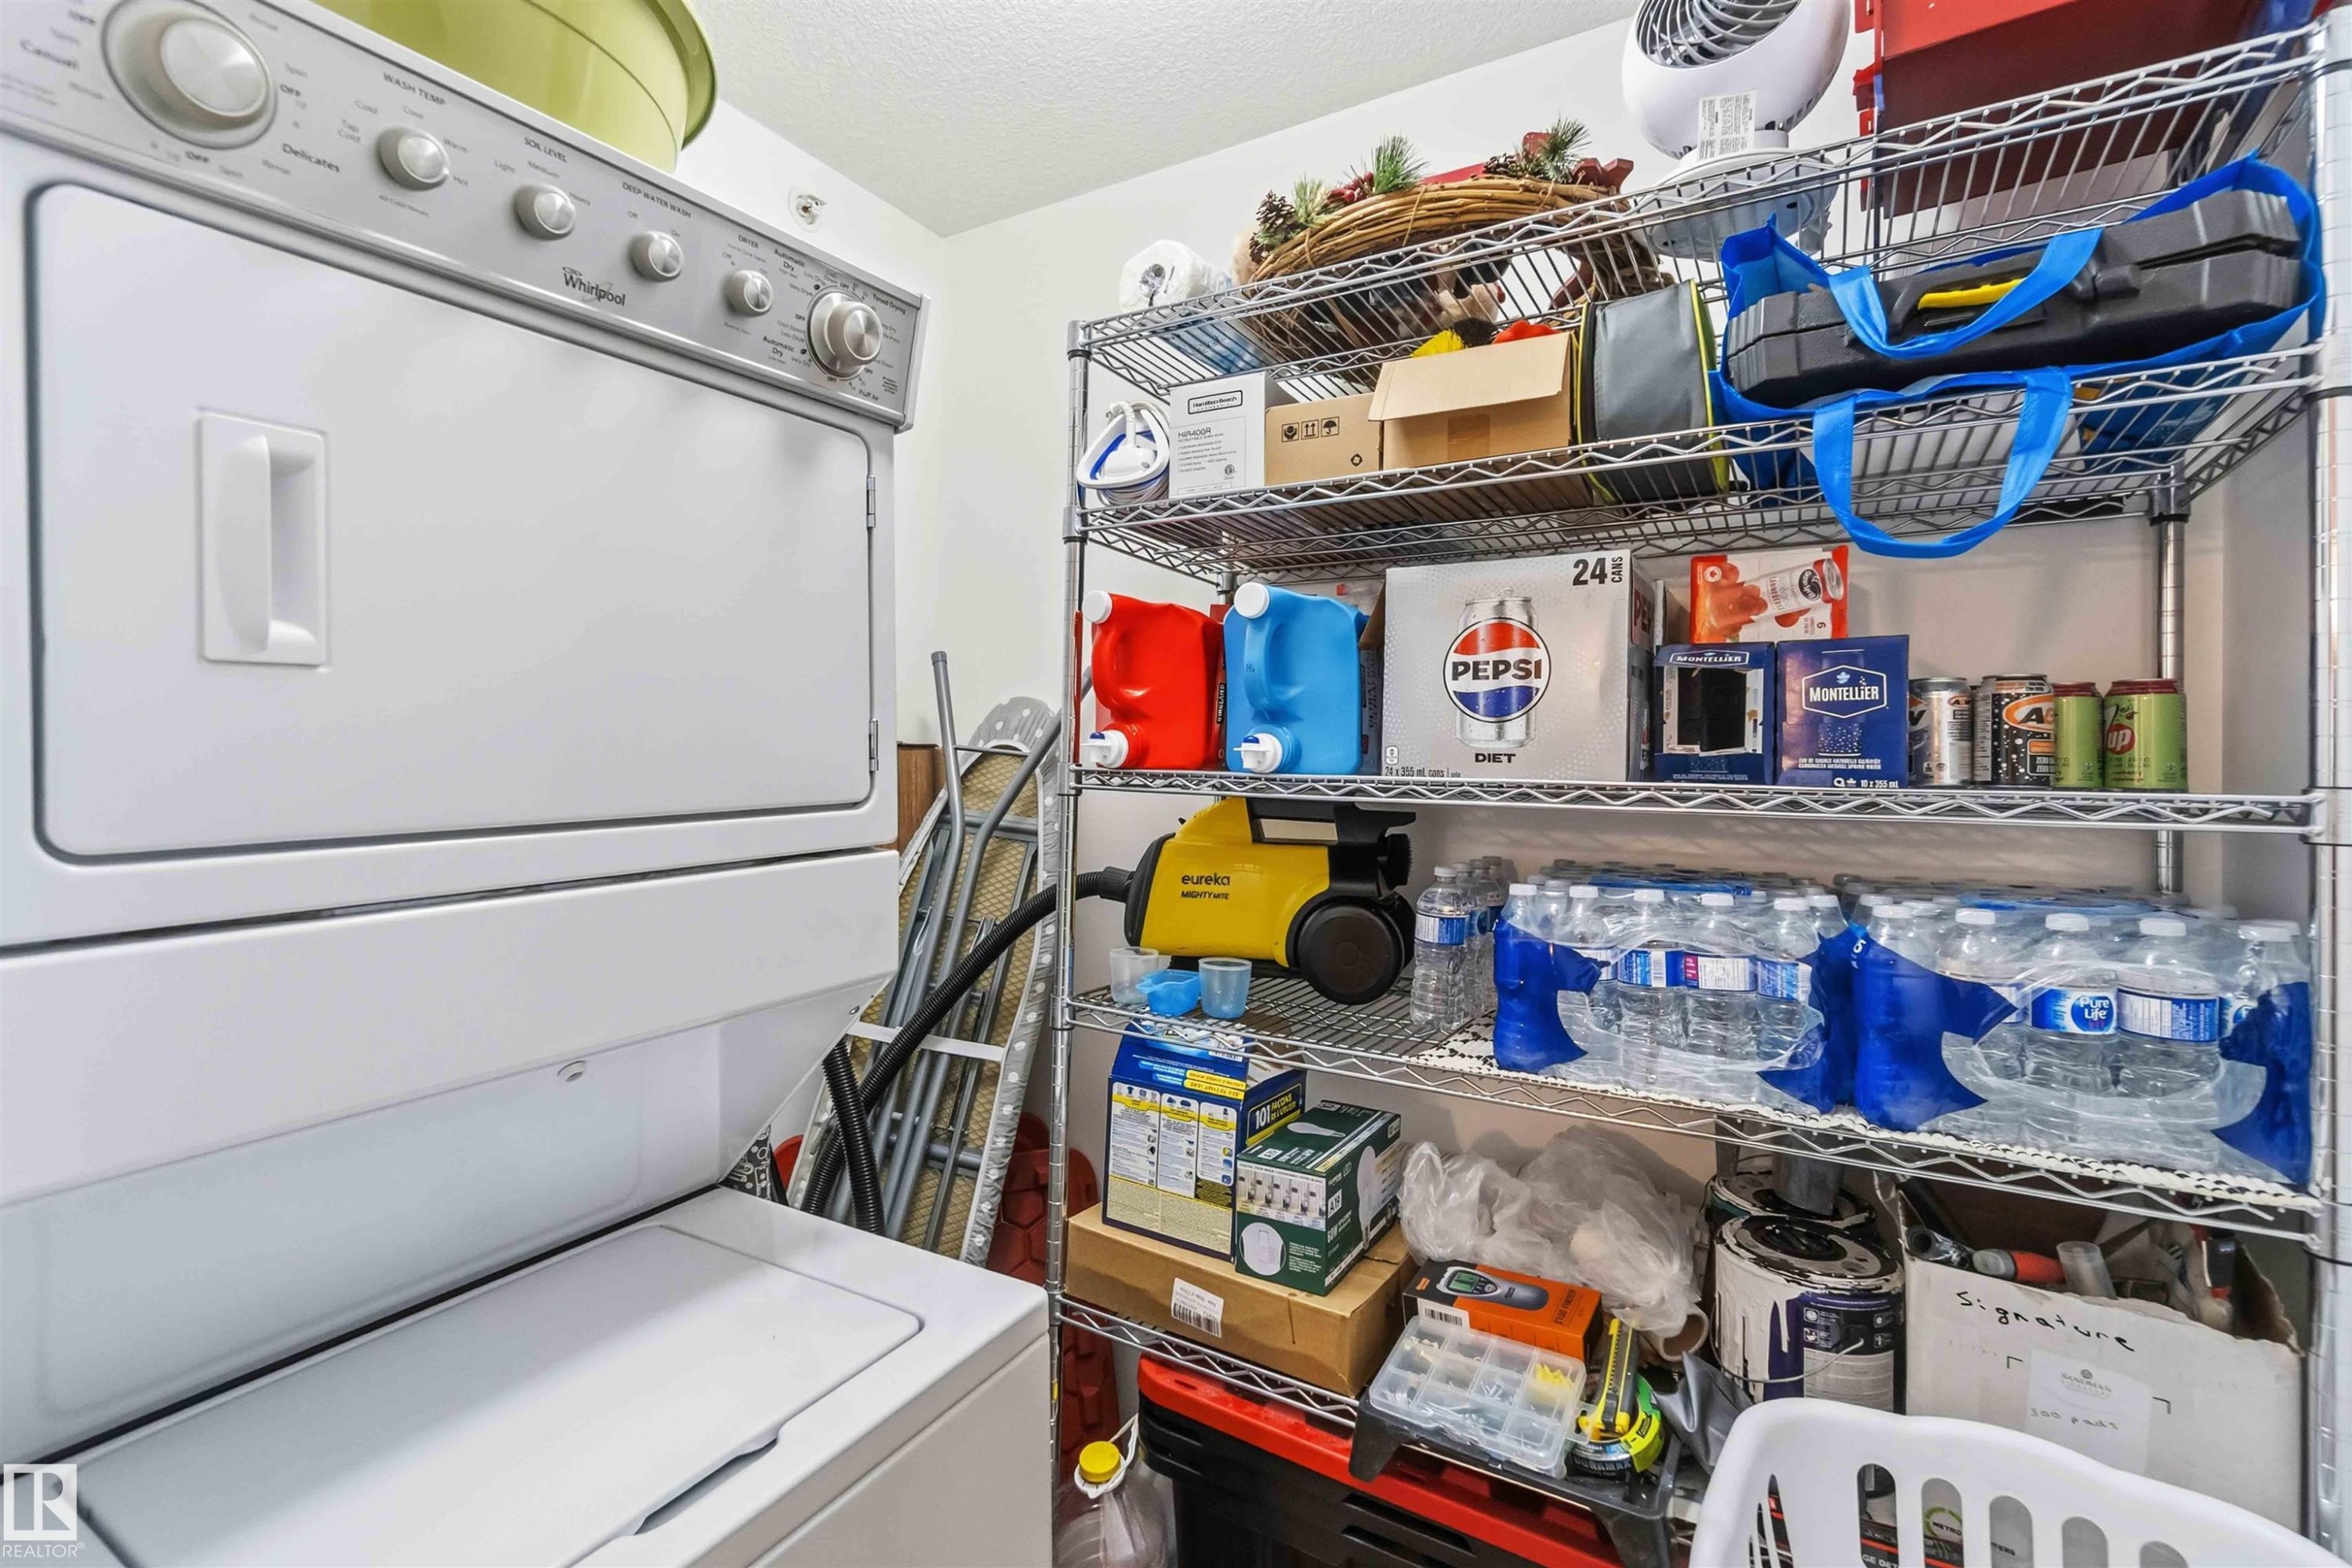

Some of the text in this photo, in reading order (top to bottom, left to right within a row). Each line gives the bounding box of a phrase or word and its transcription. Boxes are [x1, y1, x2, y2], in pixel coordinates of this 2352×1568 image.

[383, 71, 446, 106] WASH TEMP
[281, 143, 340, 172] Delicates
[524, 136, 568, 163] SOIL LEVEL
[494, 159, 516, 175] Light
[622, 181, 691, 220] DEEP WATER WASH
[738, 234, 759, 249] DRYER
[774, 248, 806, 268] Automatic
[563, 272, 626, 307] Whirlpool
[873, 294, 906, 315] Timed Drying
[763, 336, 795, 353] Automatic
[1219, 396, 1237, 405] Beach
[1573, 557, 1608, 586] 24
[1611, 556, 1623, 583] CANS
[1451, 659, 1542, 681] PEPSI
[1475, 753, 1516, 763] DIET
[1385, 767, 1393, 777] 24
[1400, 767, 1414, 778] 355
[1428, 769, 1445, 778] cans
[1181, 873, 1230, 886] eureka
[1181, 891, 1213, 899] MIGHTY
[2079, 996, 2110, 1011] Pure
[2084, 1008, 2108, 1022] Life
[1255, 1105, 1270, 1130] 101
[1956, 1290, 2135, 1352] Signature
